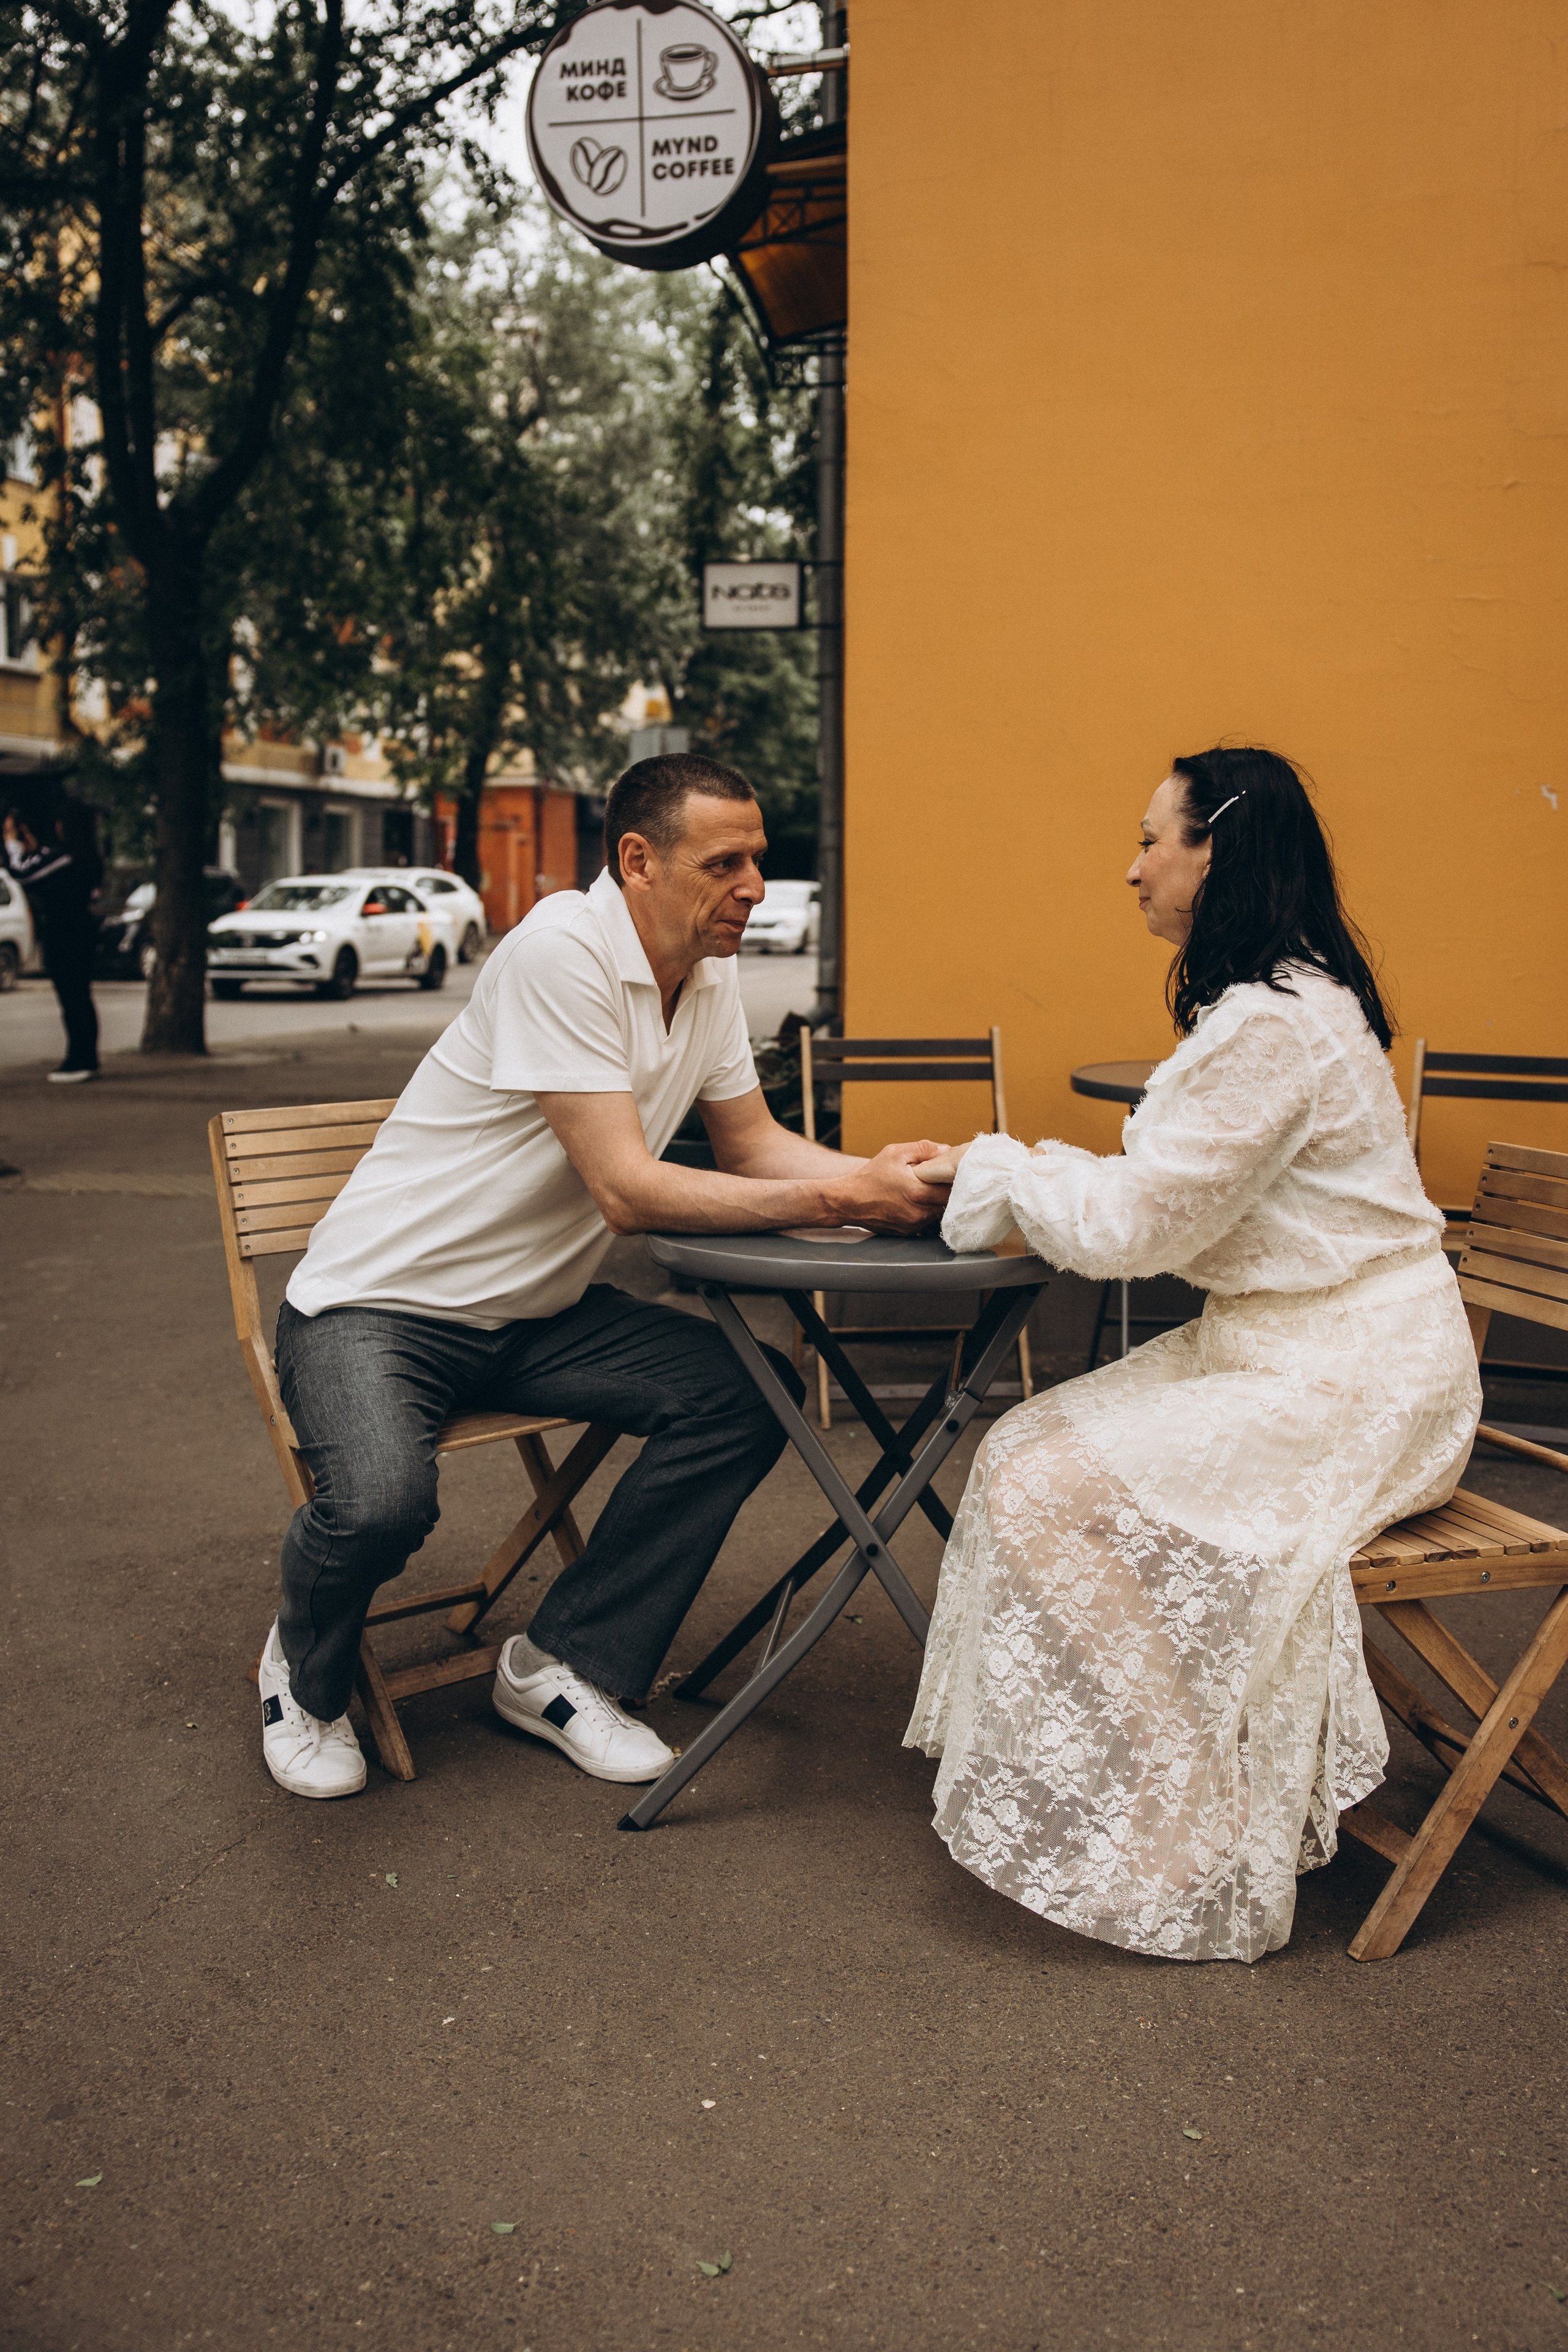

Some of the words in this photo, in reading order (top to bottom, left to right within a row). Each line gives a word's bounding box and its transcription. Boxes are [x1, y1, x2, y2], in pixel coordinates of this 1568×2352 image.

[560, 58, 626, 78] МИНД
[566, 80, 626, 102] КОФЕ
[652, 135, 718, 156] MYND
[652, 157, 734, 180] COFFEE
